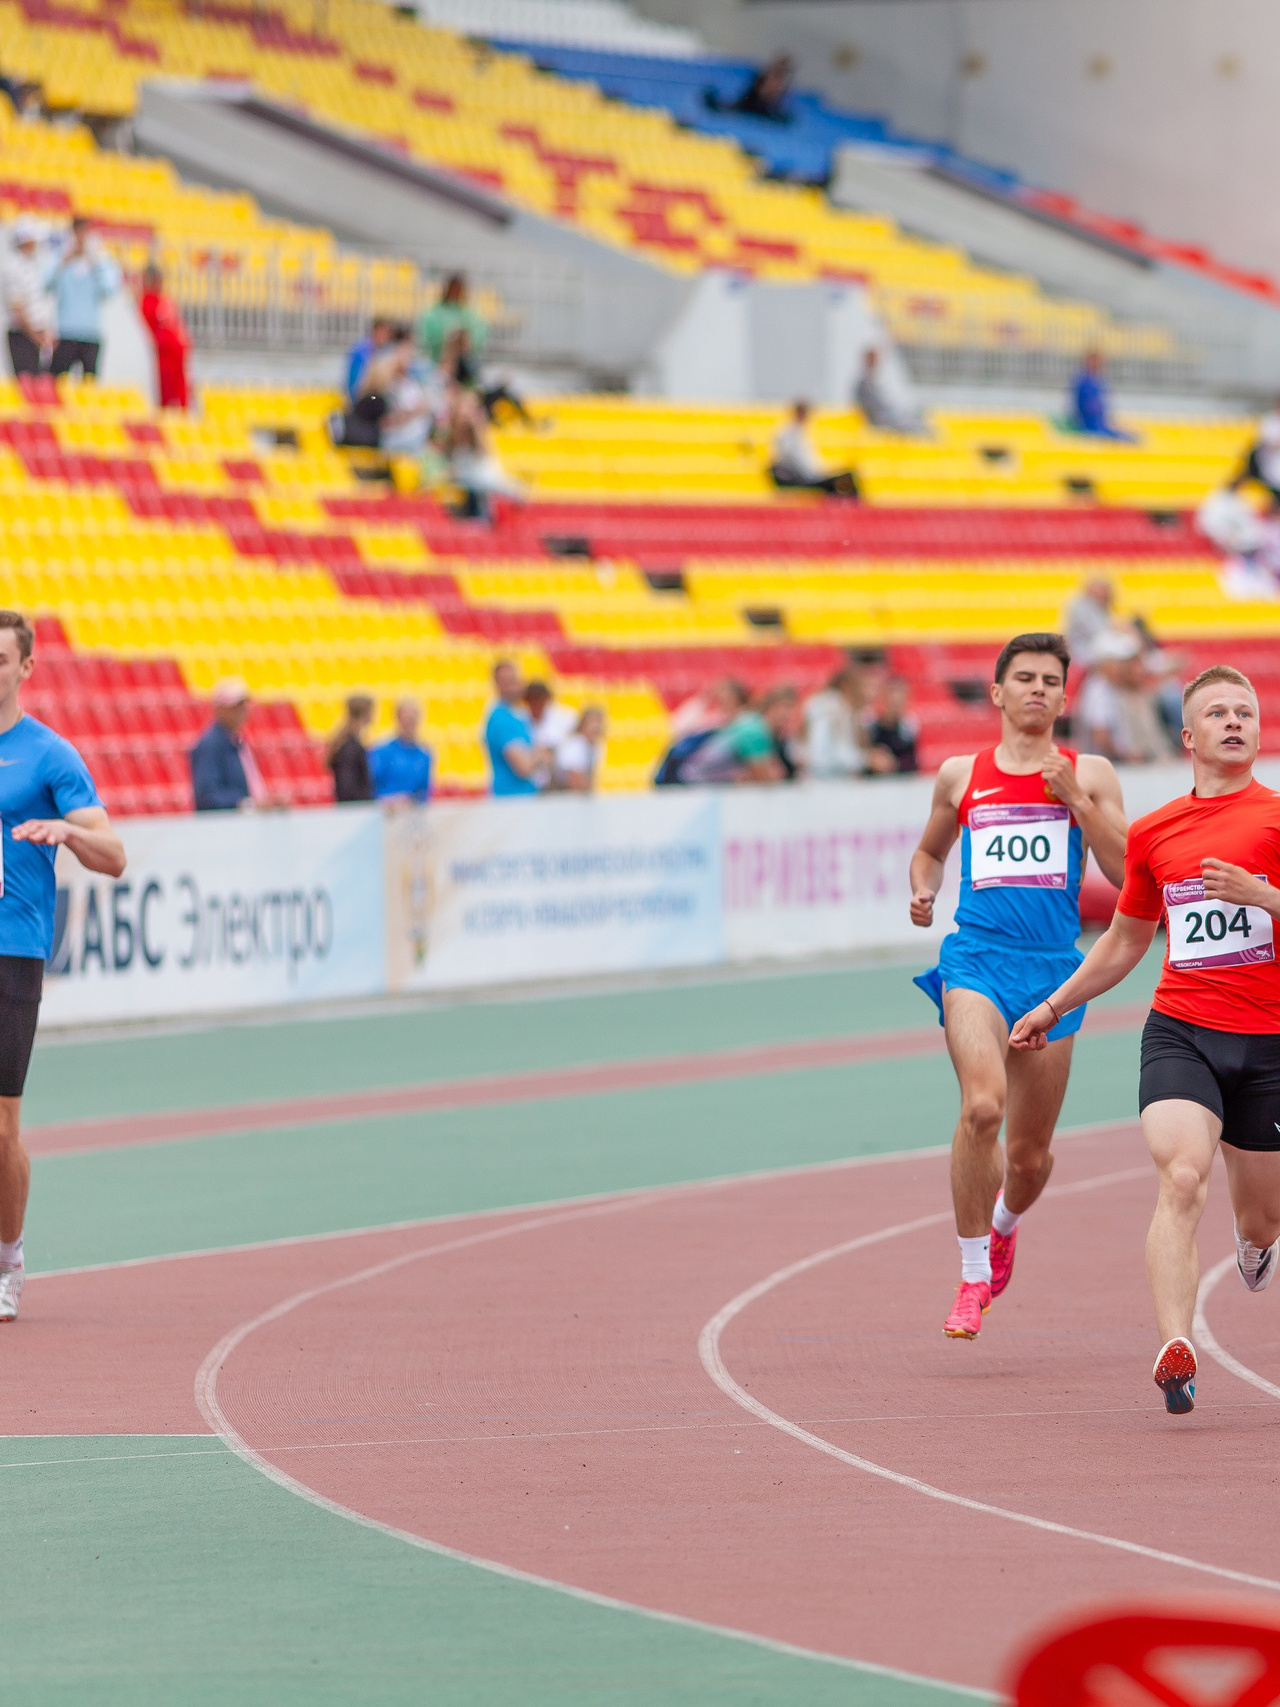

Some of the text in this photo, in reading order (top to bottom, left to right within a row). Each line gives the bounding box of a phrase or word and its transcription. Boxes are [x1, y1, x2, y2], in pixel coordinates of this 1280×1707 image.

[986, 835, 1051, 863] 400
[81, 874, 334, 983] АБС Электро
[1185, 907, 1252, 944] 204
